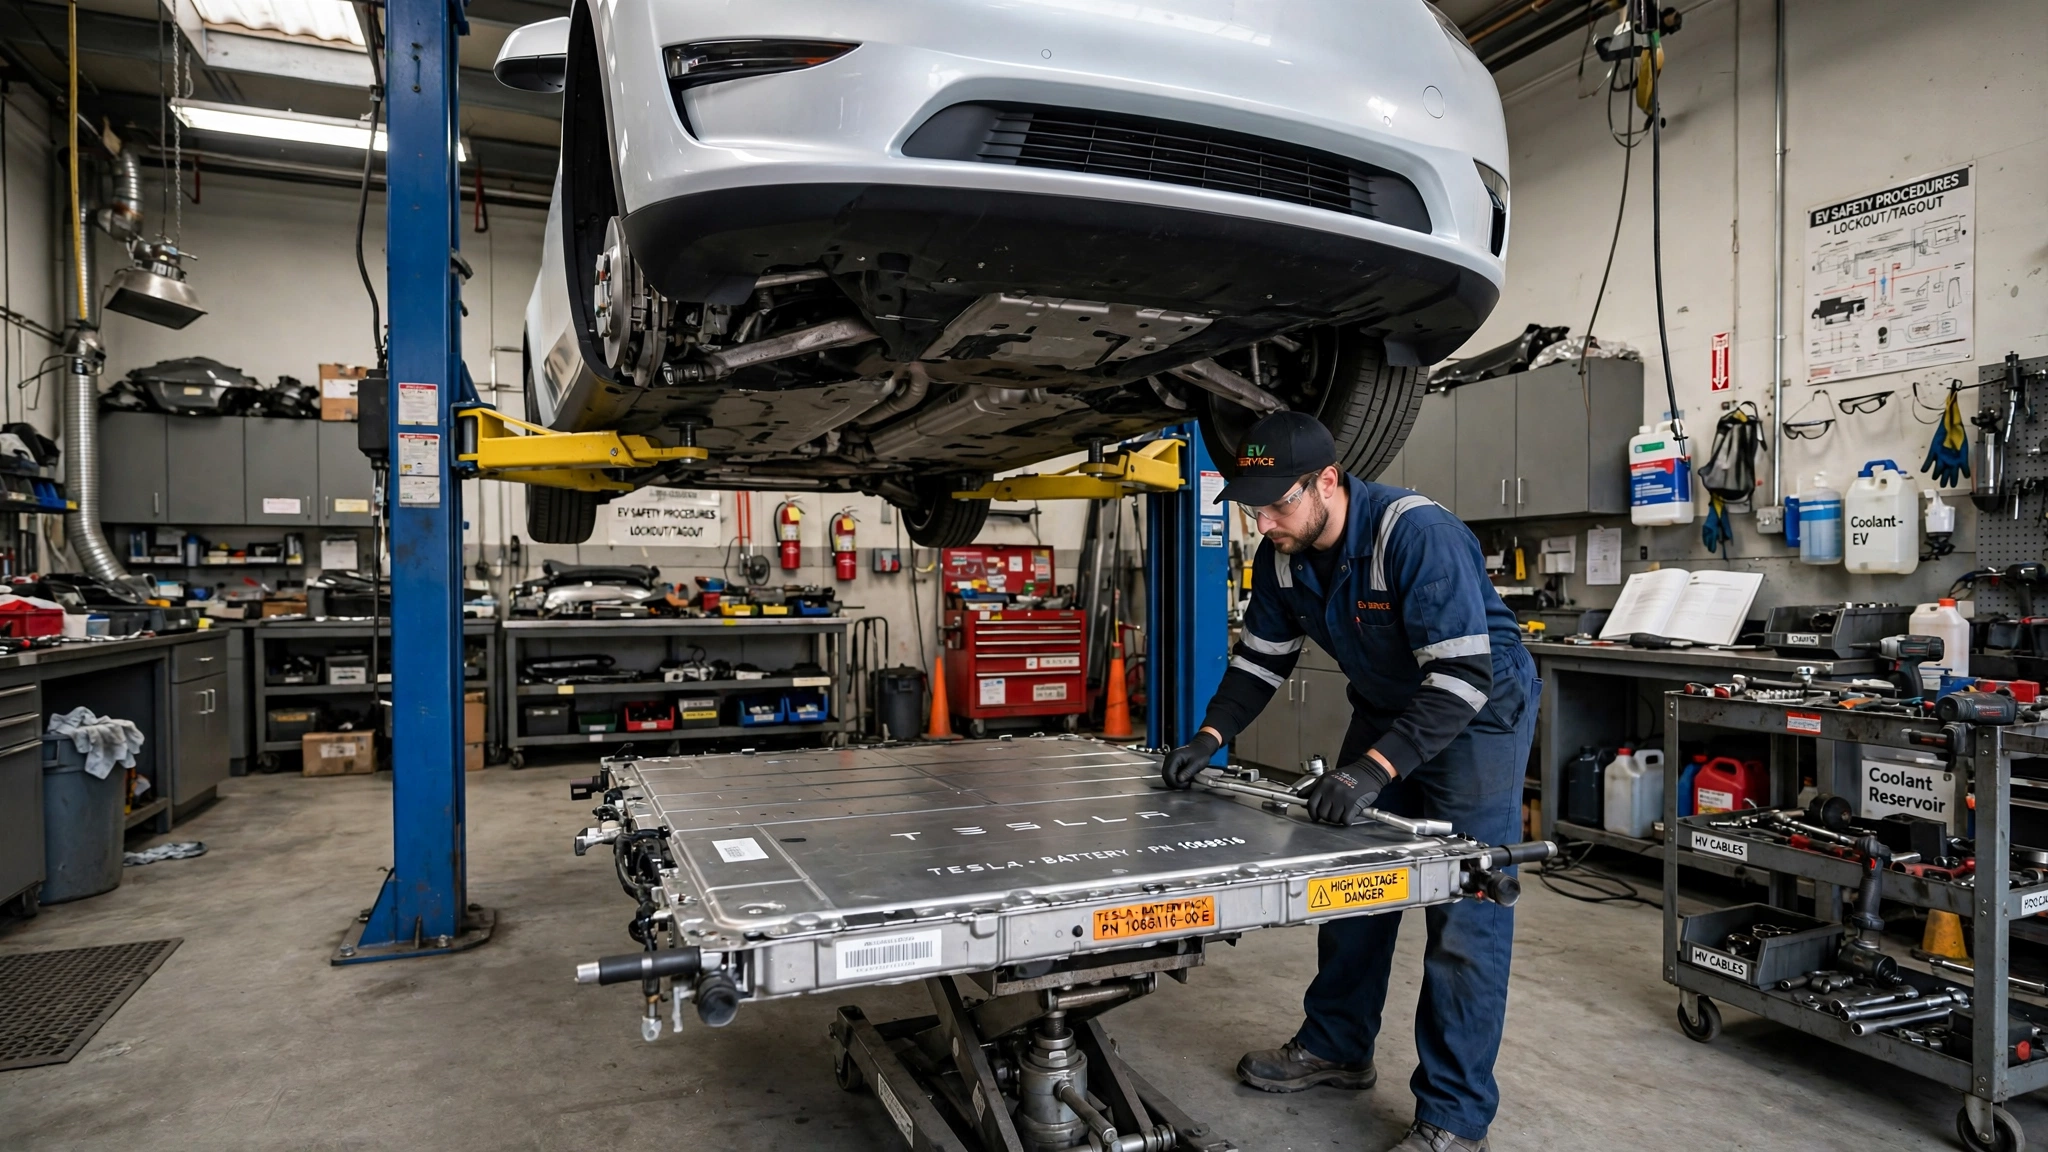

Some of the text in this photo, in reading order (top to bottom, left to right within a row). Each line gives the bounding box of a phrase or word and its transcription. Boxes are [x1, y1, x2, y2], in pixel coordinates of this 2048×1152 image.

[1815, 173, 1960, 225] EV SAFETY PROCEDURES
[1834, 195, 1944, 235] LOCKOUT/TAGOUT
[1247, 444, 1267, 457] EV
[631, 507, 661, 518] SAFETY
[1852, 532, 1869, 545] EV
[1869, 767, 1933, 791] Coolant
[1869, 786, 1946, 813] Reservoir
[1695, 835, 1744, 856] HV CABLES
[927, 860, 1024, 876] TESLA
[1041, 849, 1129, 864] BATTERY
[1331, 879, 1354, 892] HIGH
[1357, 873, 1398, 889] VOLTAGE
[1345, 888, 1384, 903] DANGER
[1102, 923, 1119, 936] PN
[1695, 950, 1744, 975] HV CABLES
